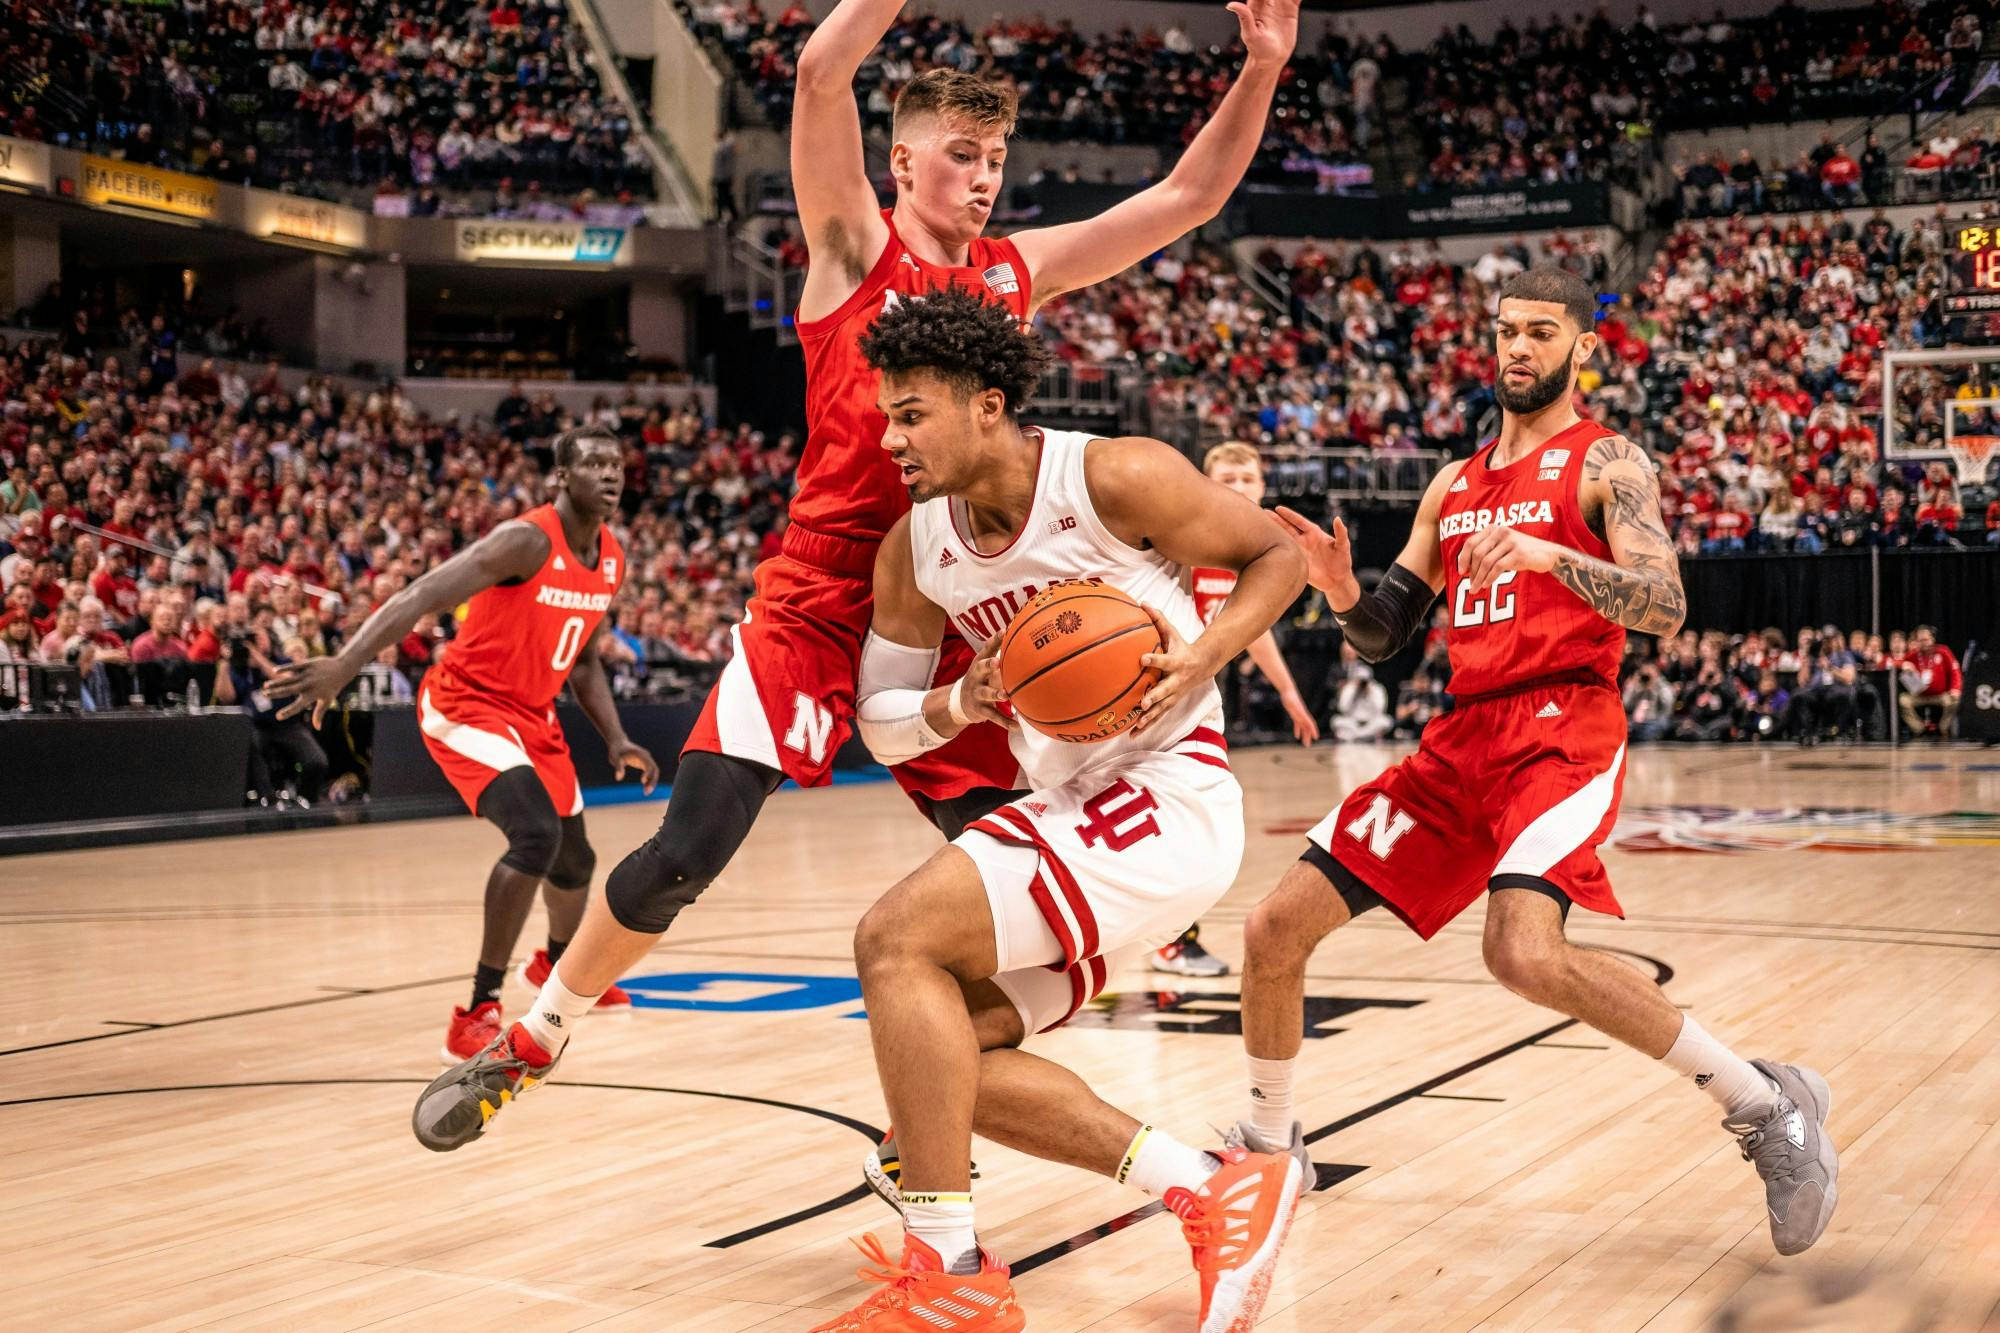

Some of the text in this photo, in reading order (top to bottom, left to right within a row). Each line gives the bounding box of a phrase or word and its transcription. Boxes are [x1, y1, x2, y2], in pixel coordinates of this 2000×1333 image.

[462, 225, 577, 249] SECTION
[1439, 501, 1553, 541] NEBRASKA
[536, 585, 612, 611] NEBRASK
[1453, 553, 1516, 628] 22
[551, 616, 584, 671] 0
[784, 690, 834, 766] N
[1056, 704, 1145, 743] SPALDIN
[1344, 792, 1417, 861] N
